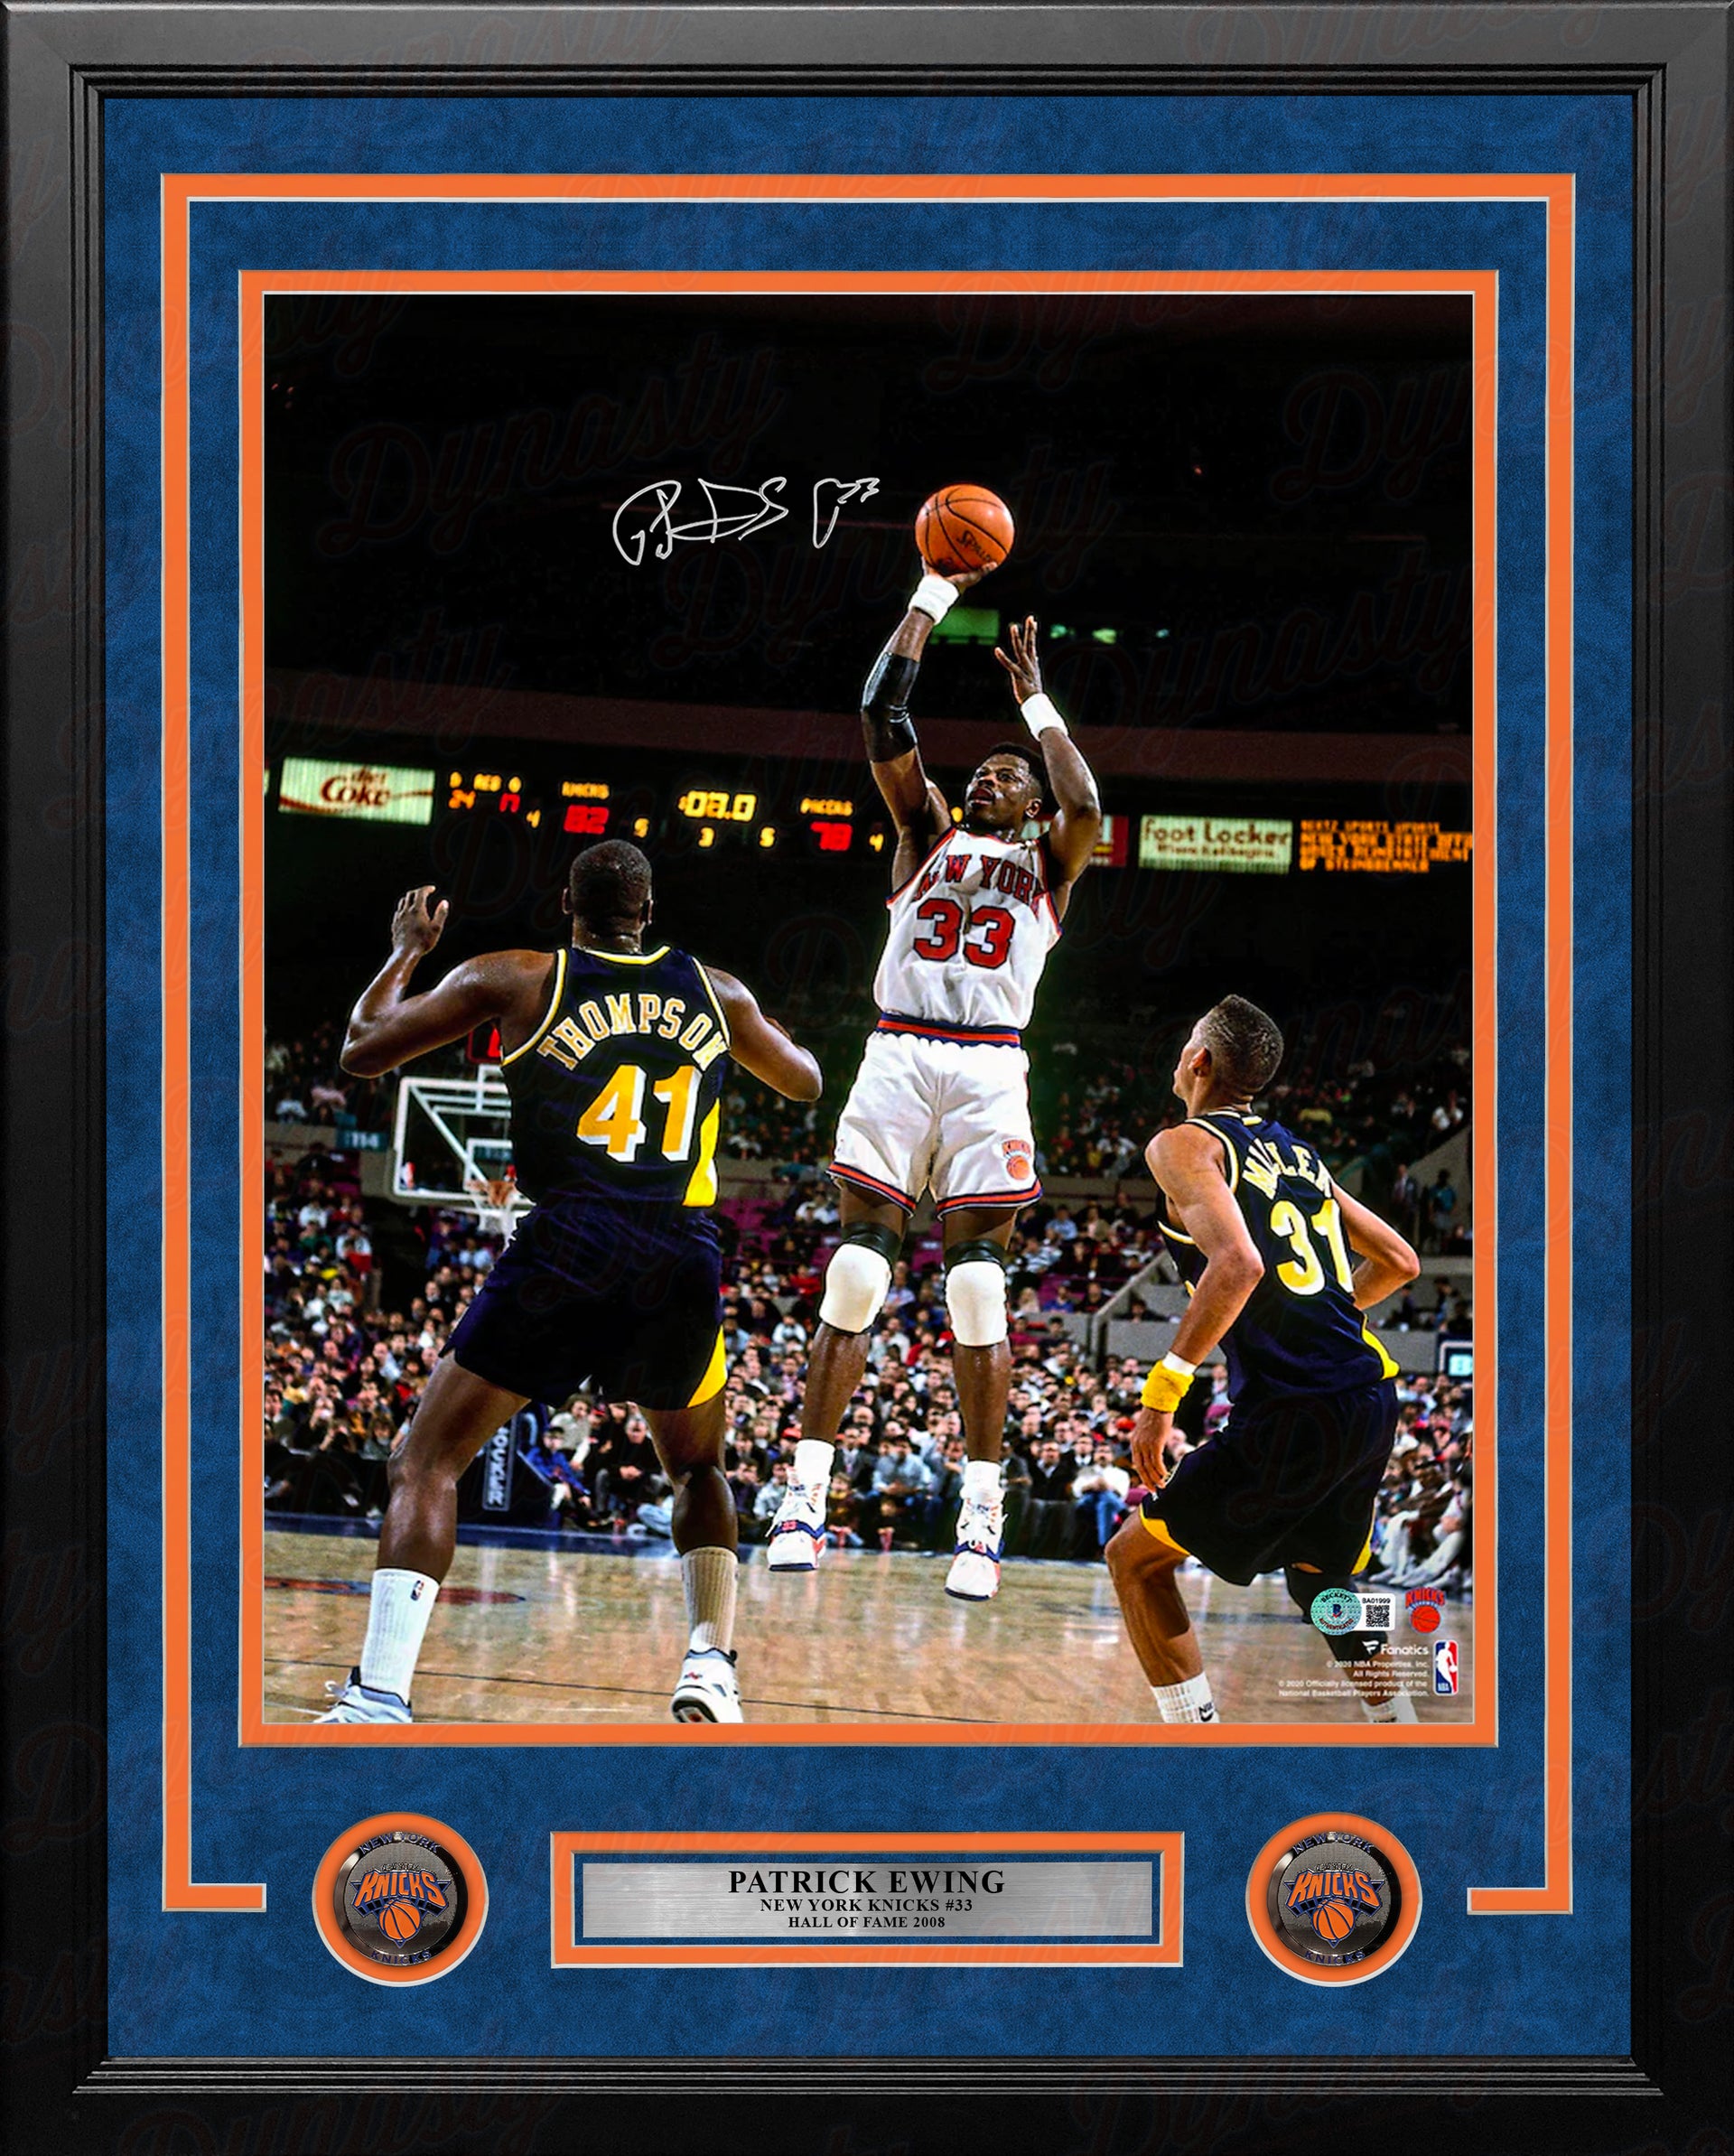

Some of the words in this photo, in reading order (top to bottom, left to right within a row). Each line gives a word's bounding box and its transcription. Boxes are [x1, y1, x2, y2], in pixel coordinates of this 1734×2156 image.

[320, 775, 392, 807] Coke
[913, 898, 1015, 970] 33
[536, 993, 729, 1071] THOMPSON
[576, 1064, 703, 1163] 41
[1270, 1199, 1354, 1296] 31
[1380, 1644, 1430, 1656] Fanatics
[359, 1833, 393, 1854] NEW
[400, 1833, 442, 1853] YORK
[1293, 1833, 1328, 1854] NEW
[1334, 1833, 1375, 1853] YORK
[353, 1870, 448, 1908] KNICKS
[728, 1870, 877, 1894] PATRICK
[889, 1870, 1005, 1894] EWING
[1287, 1870, 1382, 1908] KNICKS
[760, 1899, 802, 1911] NEW
[808, 1899, 862, 1911] YORK
[868, 1899, 939, 1912] KNICKS
[946, 1899, 973, 1911] #33
[788, 1916, 832, 1927] HALL
[838, 1916, 858, 1927] OF
[864, 1916, 908, 1927] FAME
[913, 1916, 945, 1927] 2008
[371, 1951, 432, 1965] KNICKS
[1305, 1951, 1366, 1965] KNICKS
